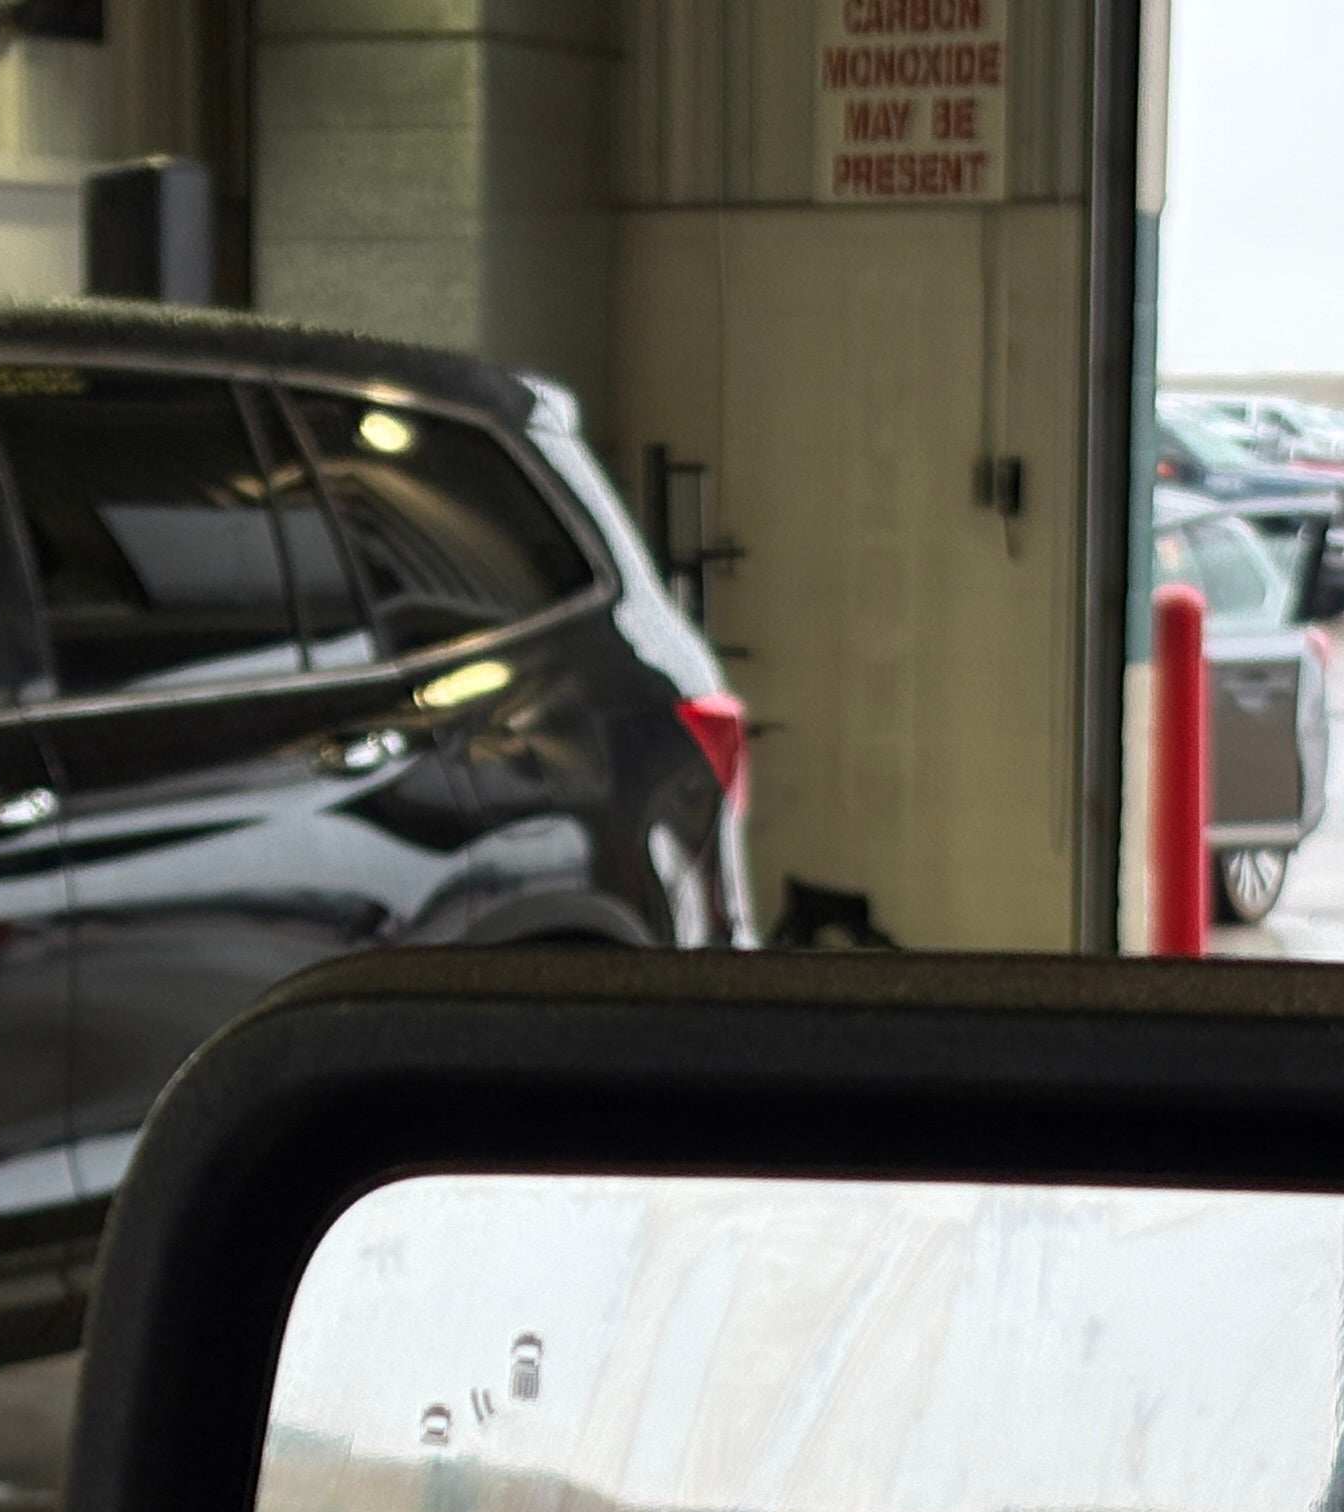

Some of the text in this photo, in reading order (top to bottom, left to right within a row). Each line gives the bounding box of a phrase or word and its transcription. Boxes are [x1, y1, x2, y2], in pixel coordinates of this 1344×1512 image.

[843, 0, 982, 33] CARBON
[823, 43, 1000, 88] MONOXIDE
[845, 97, 977, 141] MAY BE
[833, 151, 987, 196] PRESENT
